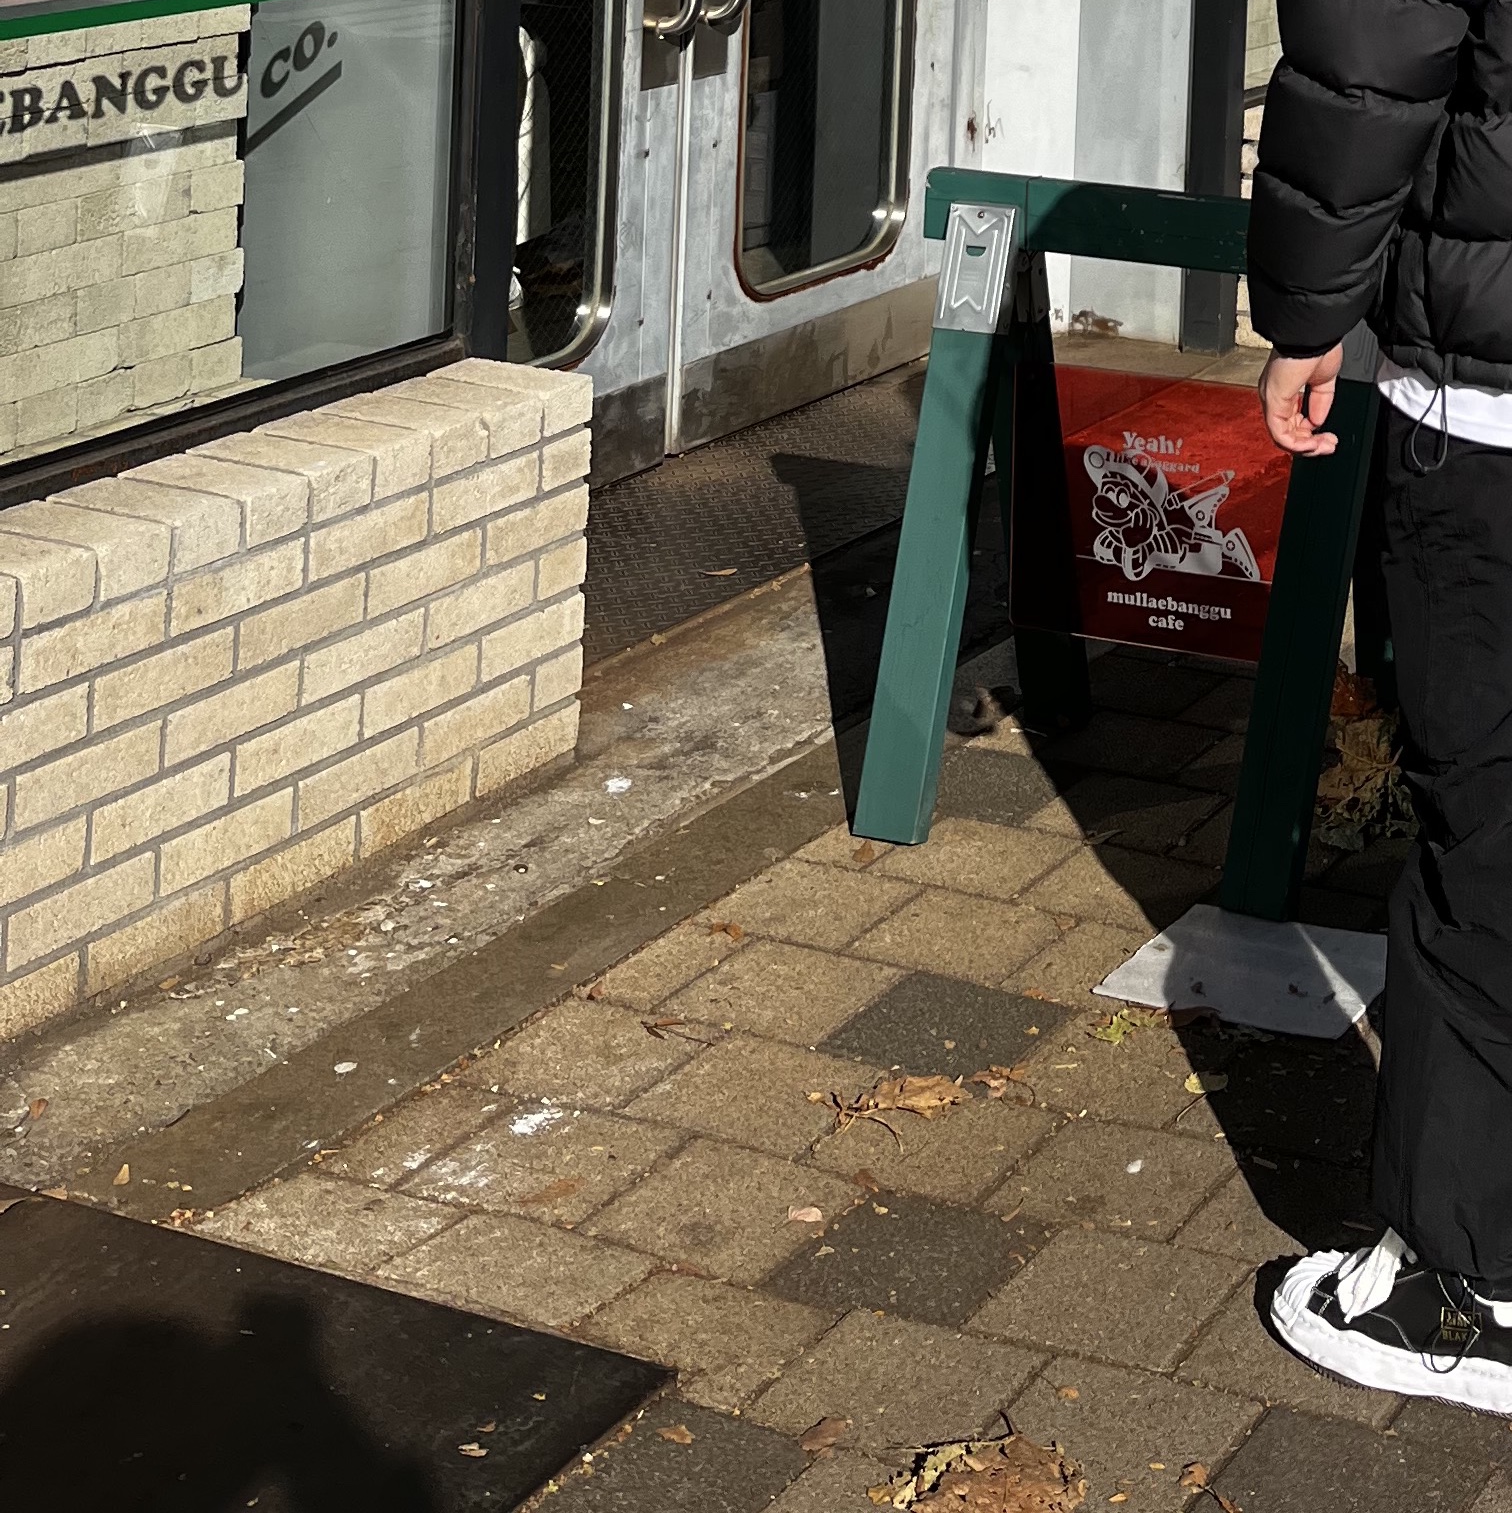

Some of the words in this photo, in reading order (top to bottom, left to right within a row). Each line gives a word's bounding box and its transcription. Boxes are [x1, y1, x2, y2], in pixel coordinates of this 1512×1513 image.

[0, 54, 243, 138] BANGGU
[1121, 431, 1184, 456] Yeah!
[1106, 591, 1232, 621] mullaebanggu
[1148, 614, 1185, 631] cafe
